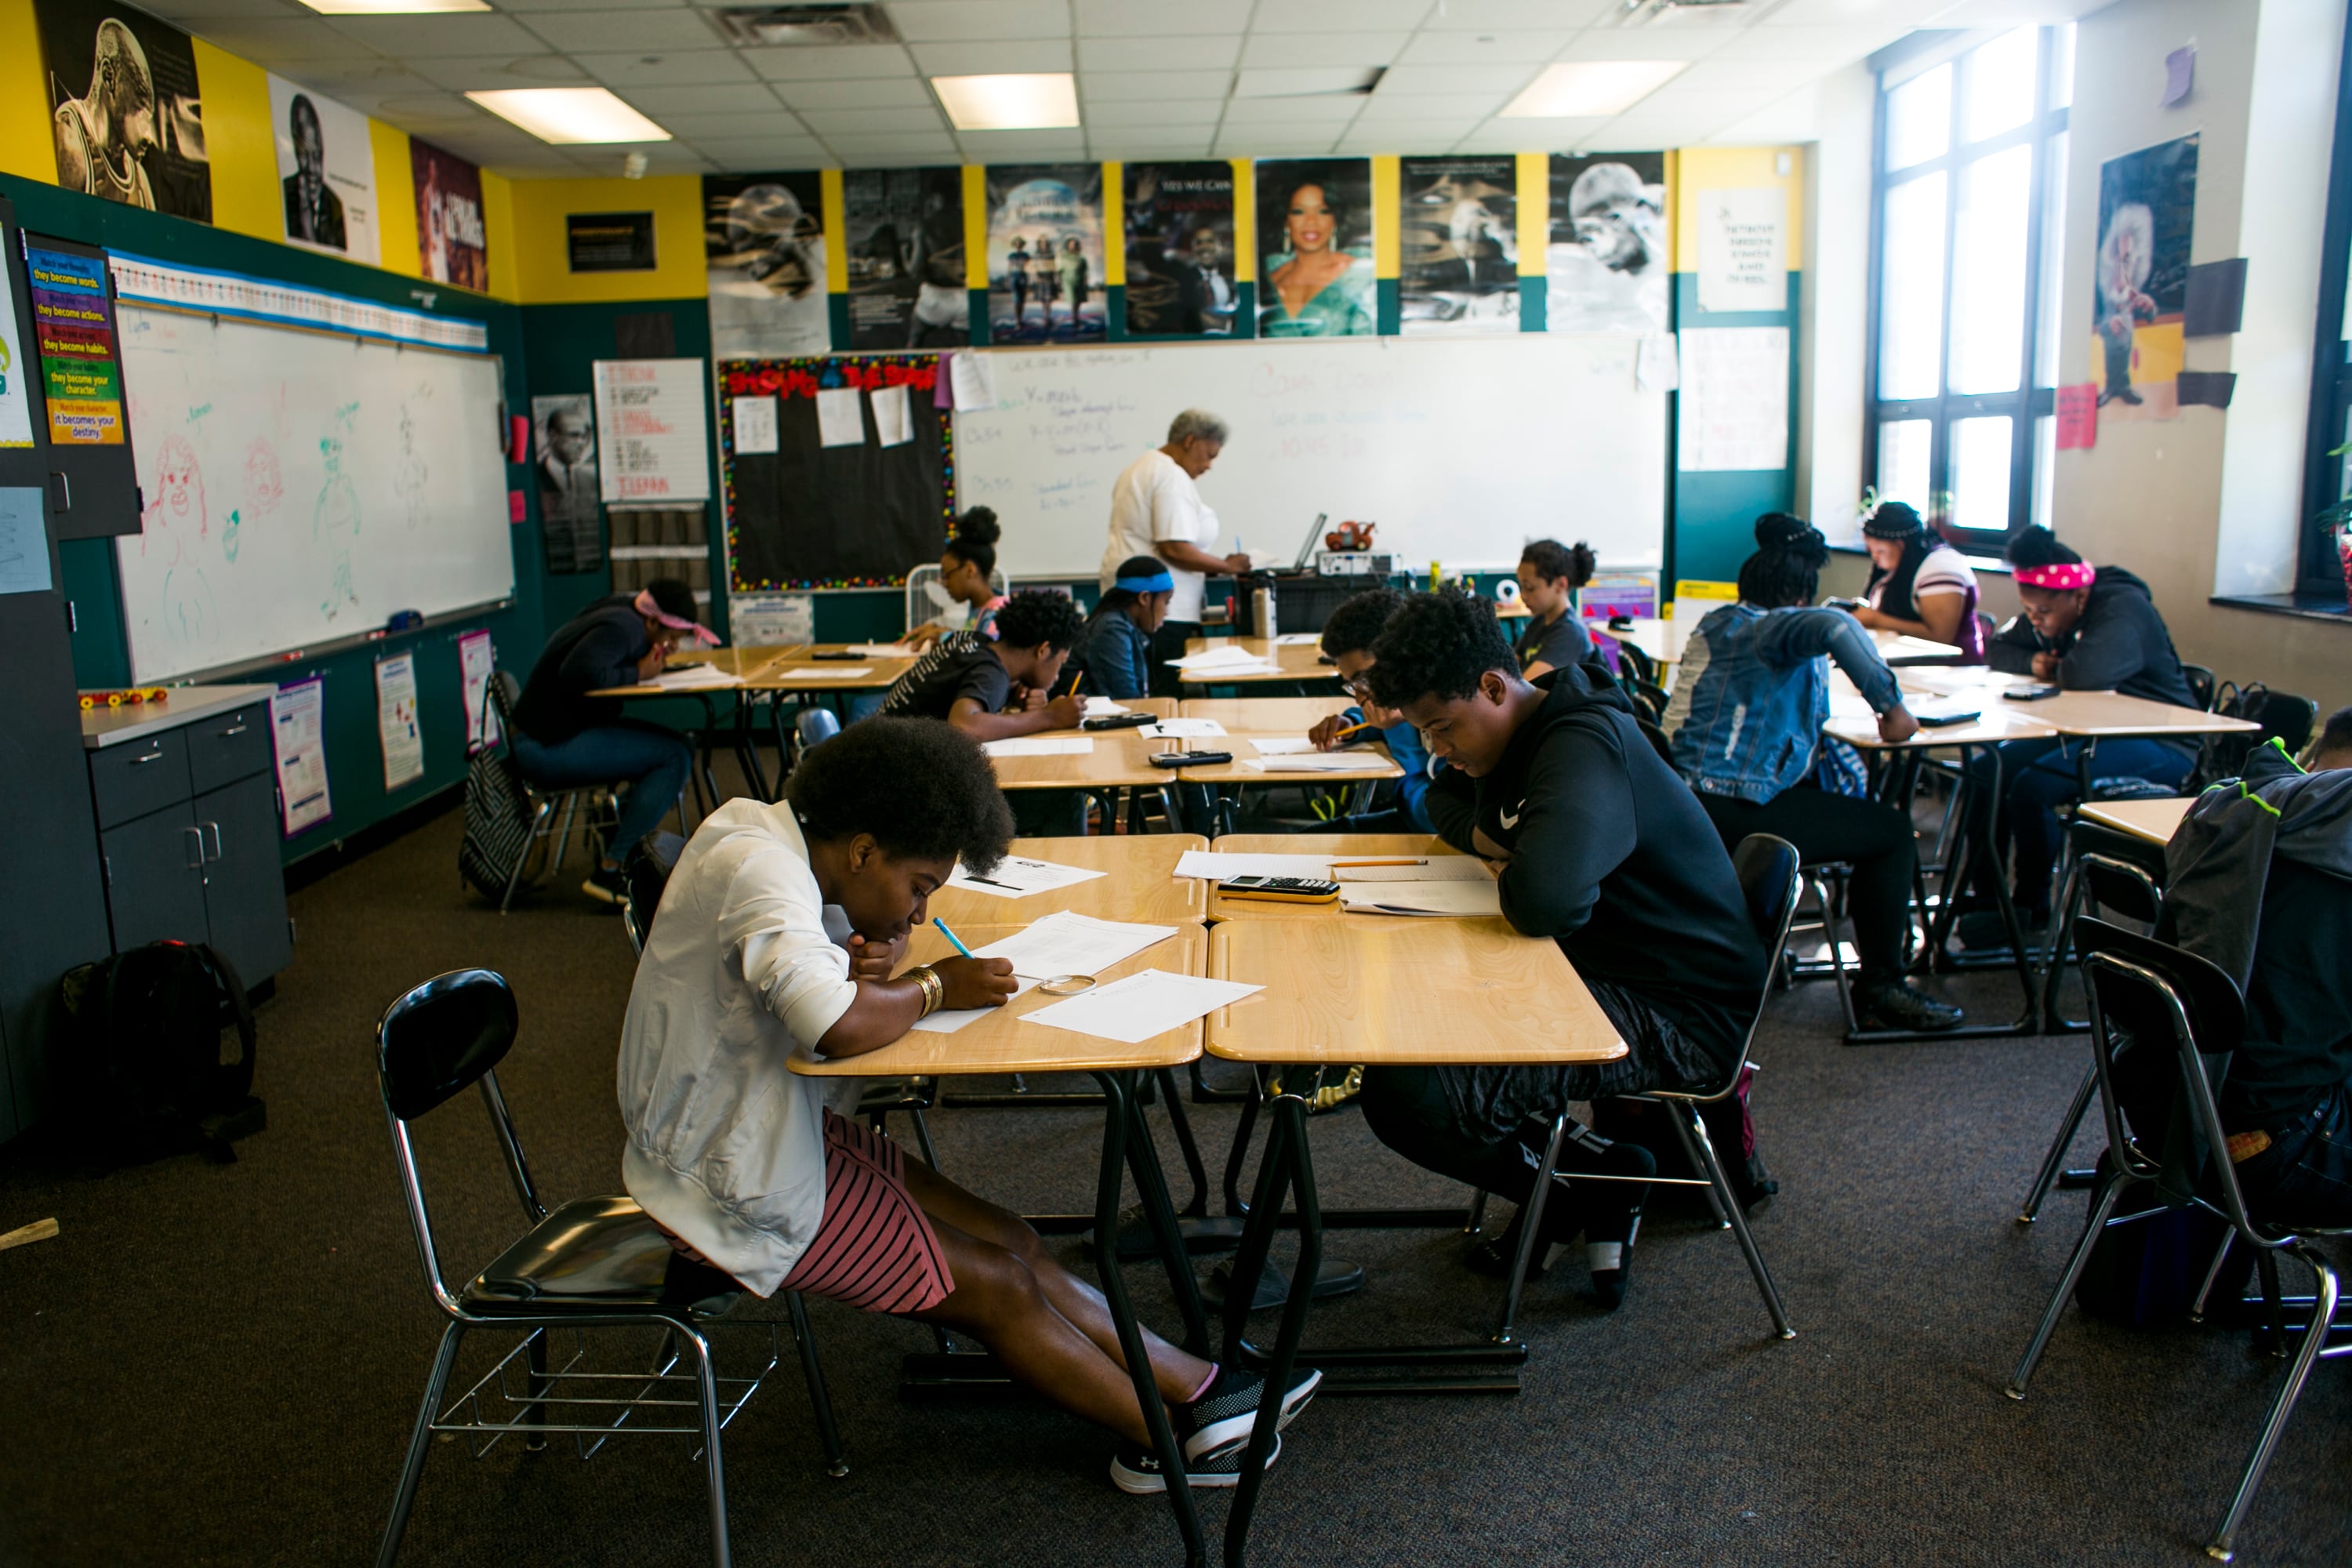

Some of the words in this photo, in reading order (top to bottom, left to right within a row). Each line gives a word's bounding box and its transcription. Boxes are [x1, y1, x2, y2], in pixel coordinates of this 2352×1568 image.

[1162, 180, 1183, 192] YES
[1185, 180, 1203, 191] WE
[34, 268, 49, 283] they
[50, 270, 78, 285] become
[78, 278, 100, 289] words.
[38, 303, 53, 318] they
[53, 305, 80, 318] become
[81, 310, 106, 322] actions.
[44, 339, 59, 352] they
[59, 339, 85, 353] become
[85, 343, 109, 354] habits.
[51, 371, 66, 384] they
[67, 372, 93, 385] become
[93, 376, 109, 386] your
[65, 384, 97, 395] character.
[54, 412, 62, 425] it
[62, 412, 96, 426] becomes
[97, 417, 115, 428] your
[72, 426, 102, 439] destiny.
